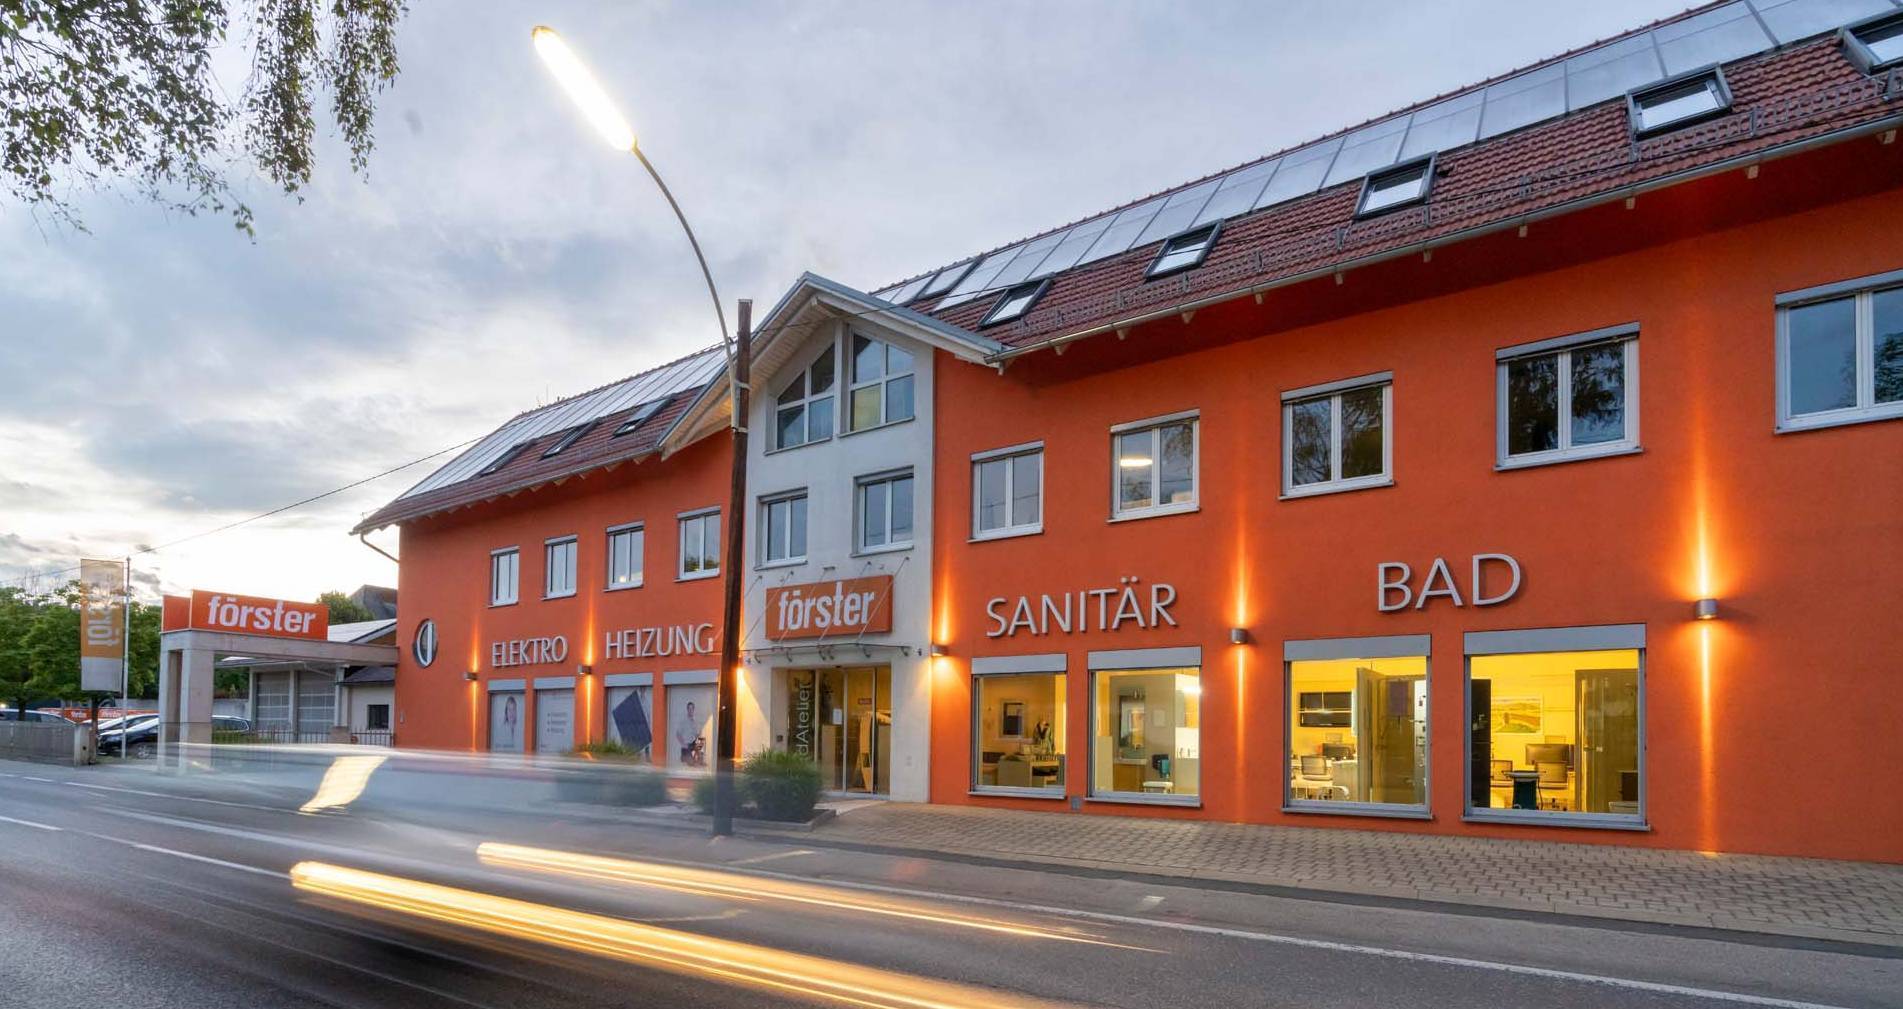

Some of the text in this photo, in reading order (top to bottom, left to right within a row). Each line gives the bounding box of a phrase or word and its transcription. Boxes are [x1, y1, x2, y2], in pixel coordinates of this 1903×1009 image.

[778, 581, 875, 631] förster
[986, 576, 1177, 638] SANITÄR
[1378, 553, 1521, 611] BAD
[207, 595, 316, 633] förster
[492, 635, 568, 667] ELEKTRO
[606, 623, 714, 659] HEIZUNG
[796, 682, 811, 757] dAtelier
